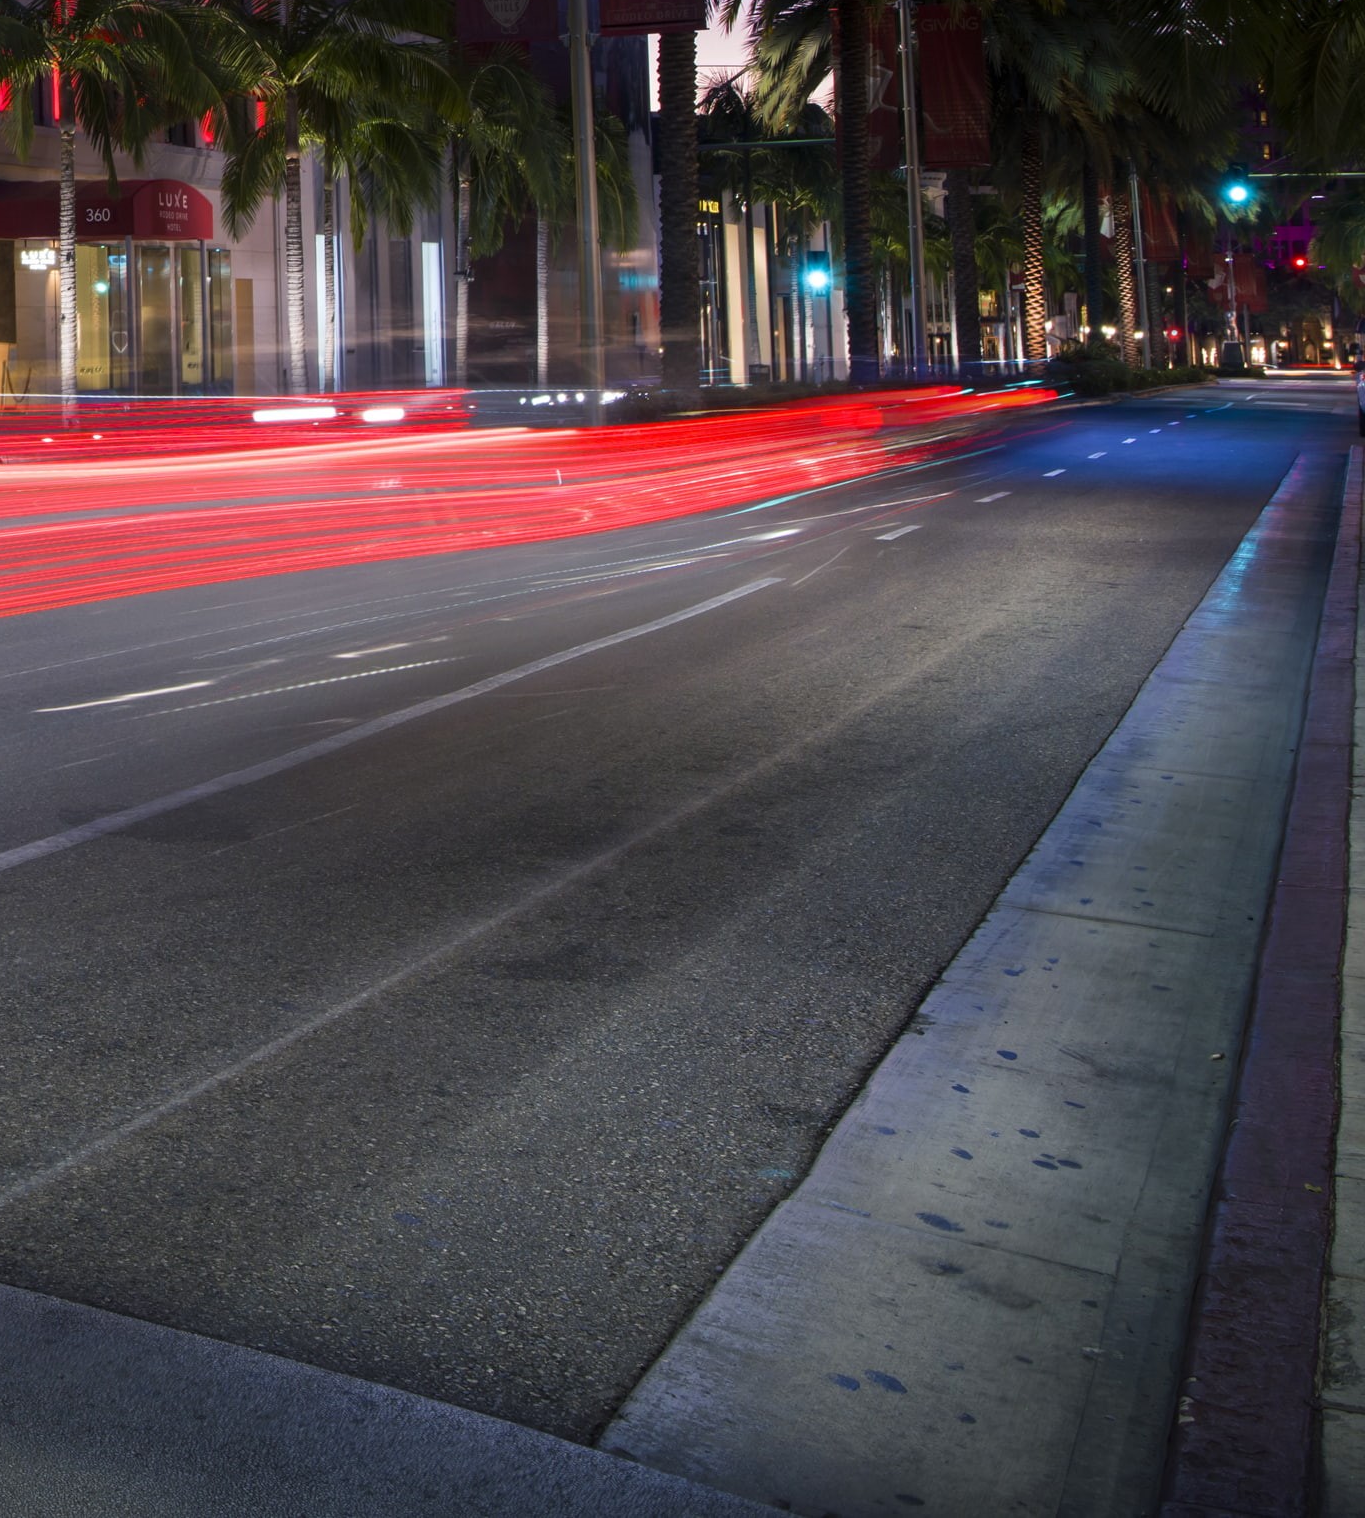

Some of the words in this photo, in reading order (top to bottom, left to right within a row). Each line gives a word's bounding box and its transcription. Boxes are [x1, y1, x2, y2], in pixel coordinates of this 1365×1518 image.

[656, 8, 690, 19] DRIVE
[921, 17, 979, 32] GIVING
[159, 190, 188, 209] LUXE
[86, 208, 110, 222] 360
[159, 211, 175, 221] RODEO
[175, 212, 189, 221] DRIVE
[167, 223, 182, 232] HOTEL
